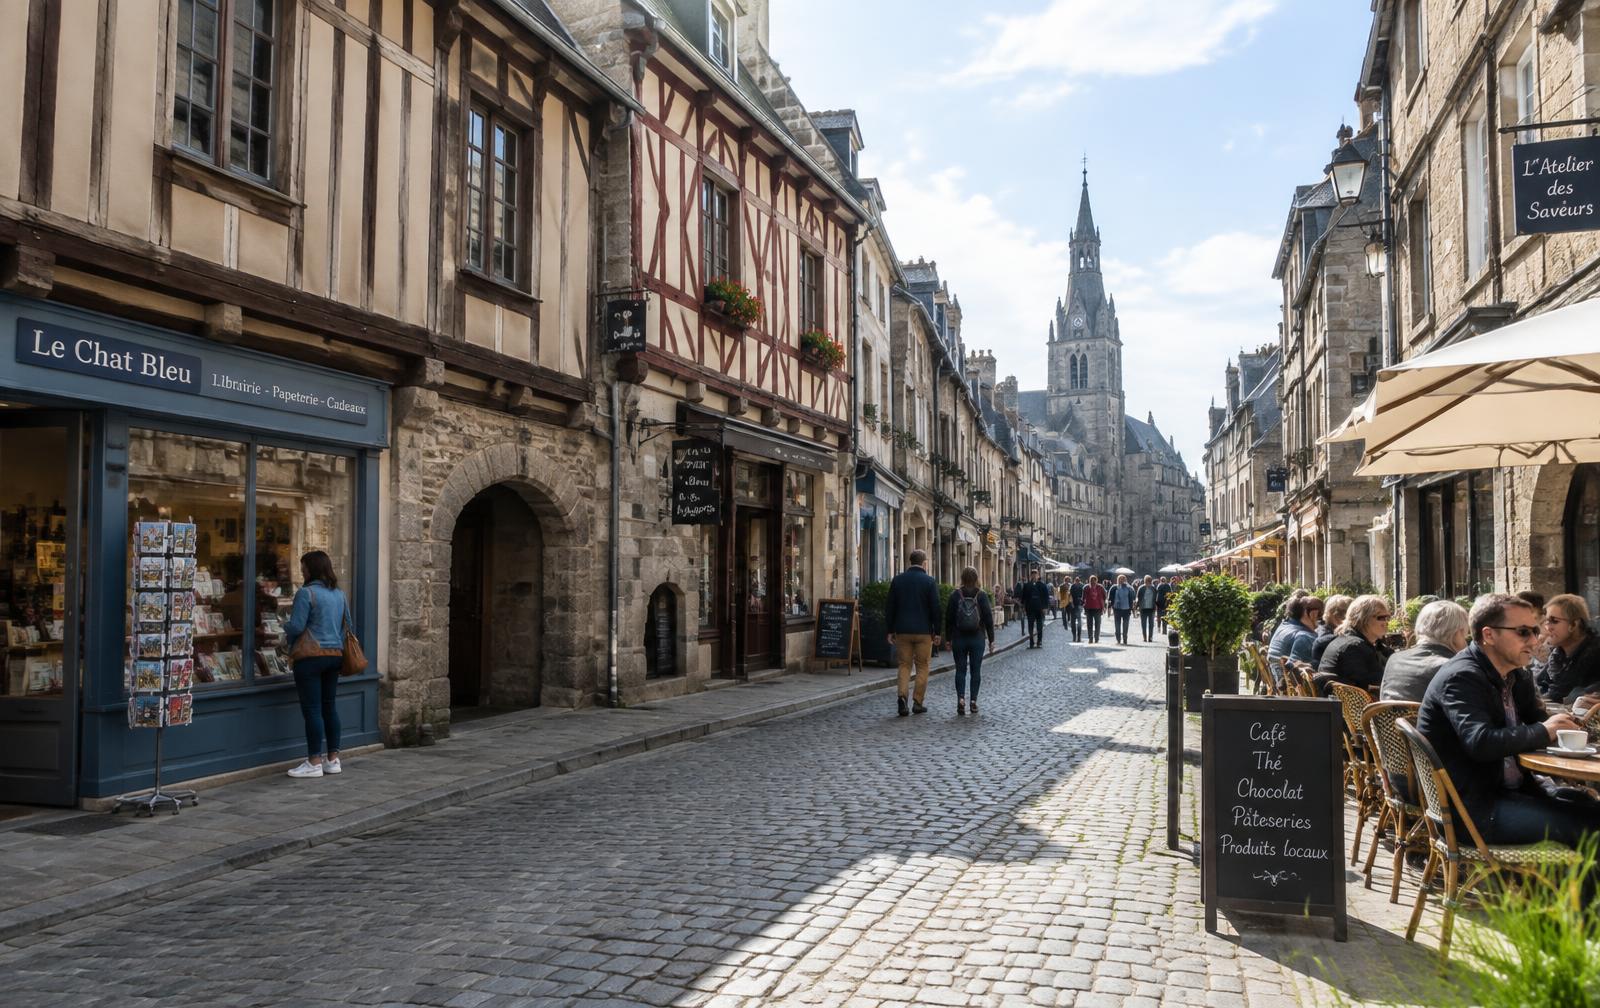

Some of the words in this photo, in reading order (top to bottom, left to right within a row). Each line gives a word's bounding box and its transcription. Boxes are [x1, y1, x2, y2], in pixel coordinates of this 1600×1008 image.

[1548, 179, 1573, 196] des
[32, 329, 65, 359] Le
[74, 339, 133, 373] Chat
[140, 353, 192, 384] Bleu
[272, 385, 319, 407] Papeterie
[1250, 722, 1286, 748] Café
[1252, 751, 1283, 770] Thé
[1237, 777, 1304, 800] Chocolat
[1220, 833, 1276, 857] Produits
[1283, 839, 1329, 860] locaux
